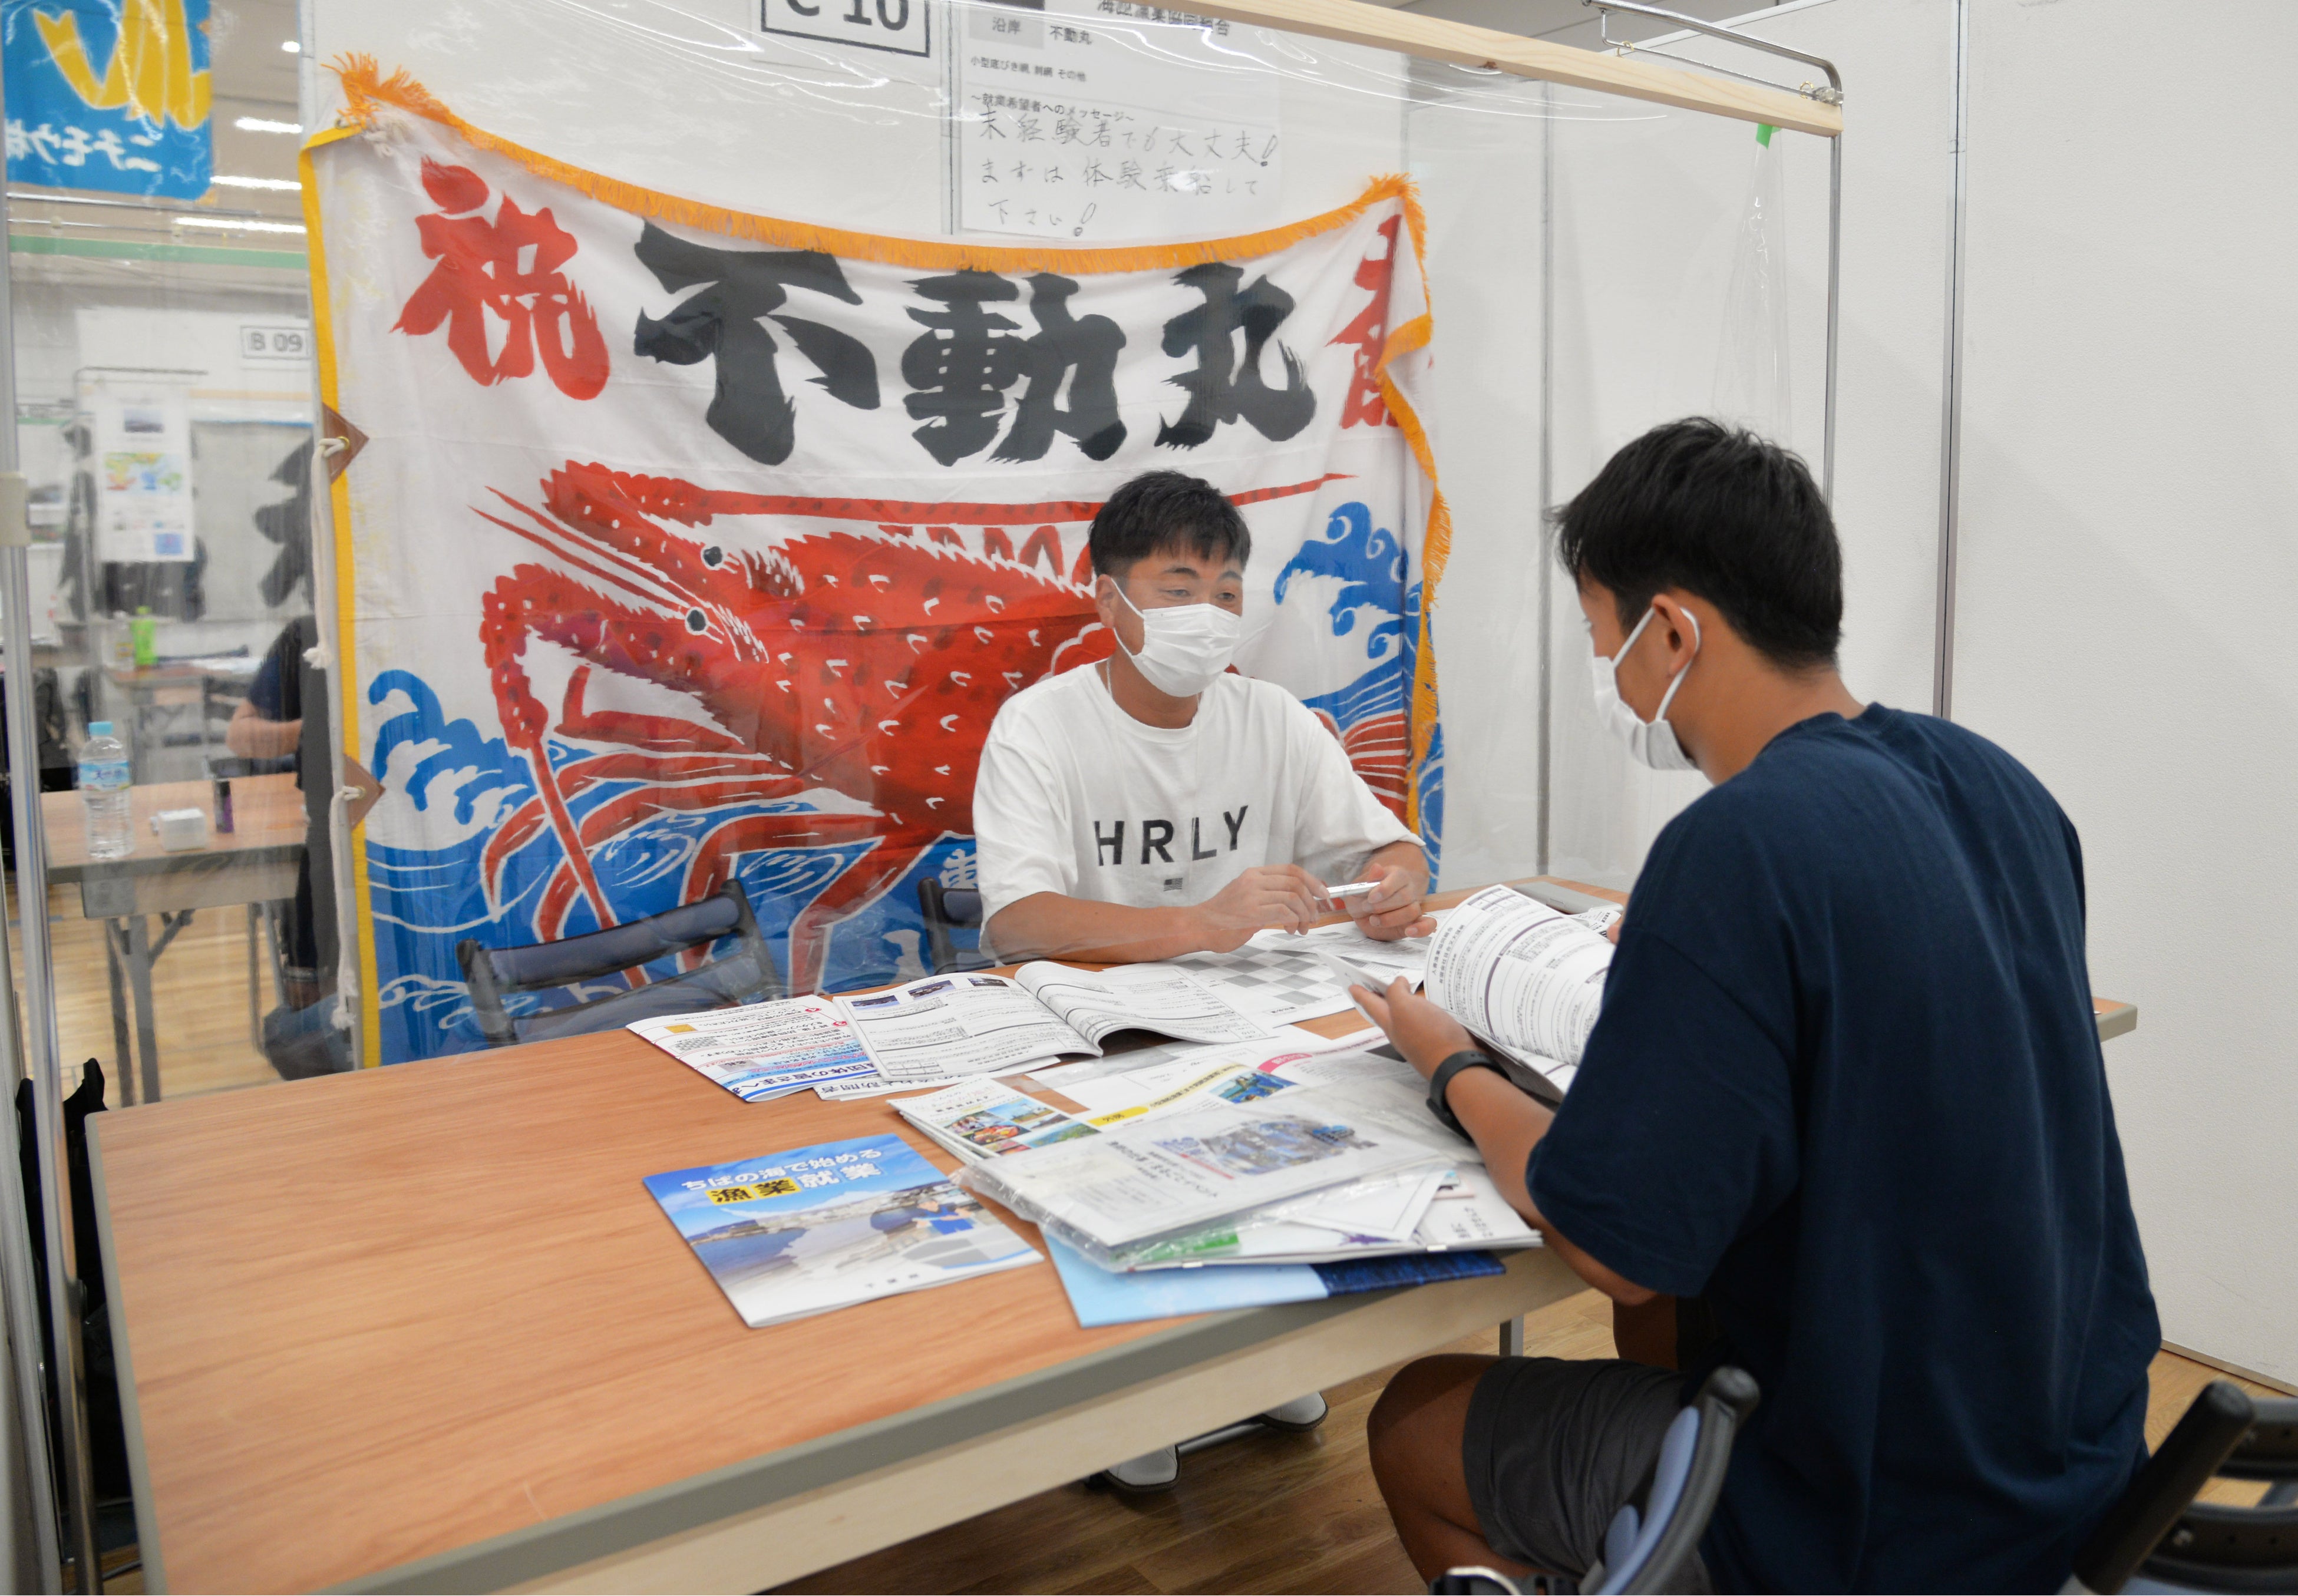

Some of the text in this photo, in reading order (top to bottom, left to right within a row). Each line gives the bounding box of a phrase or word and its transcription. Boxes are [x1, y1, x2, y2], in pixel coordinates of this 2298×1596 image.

[992, 17, 1091, 45] 沿岸 不動丸
[391, 158, 610, 402] 祝
[633, 220, 1316, 467] 不動丸
[273, 332, 303, 352] 09
[1094, 805, 1249, 867] HRLY
[681, 1148, 882, 1191] ちばの海で始める
[711, 1162, 882, 1203] 漁業就業
